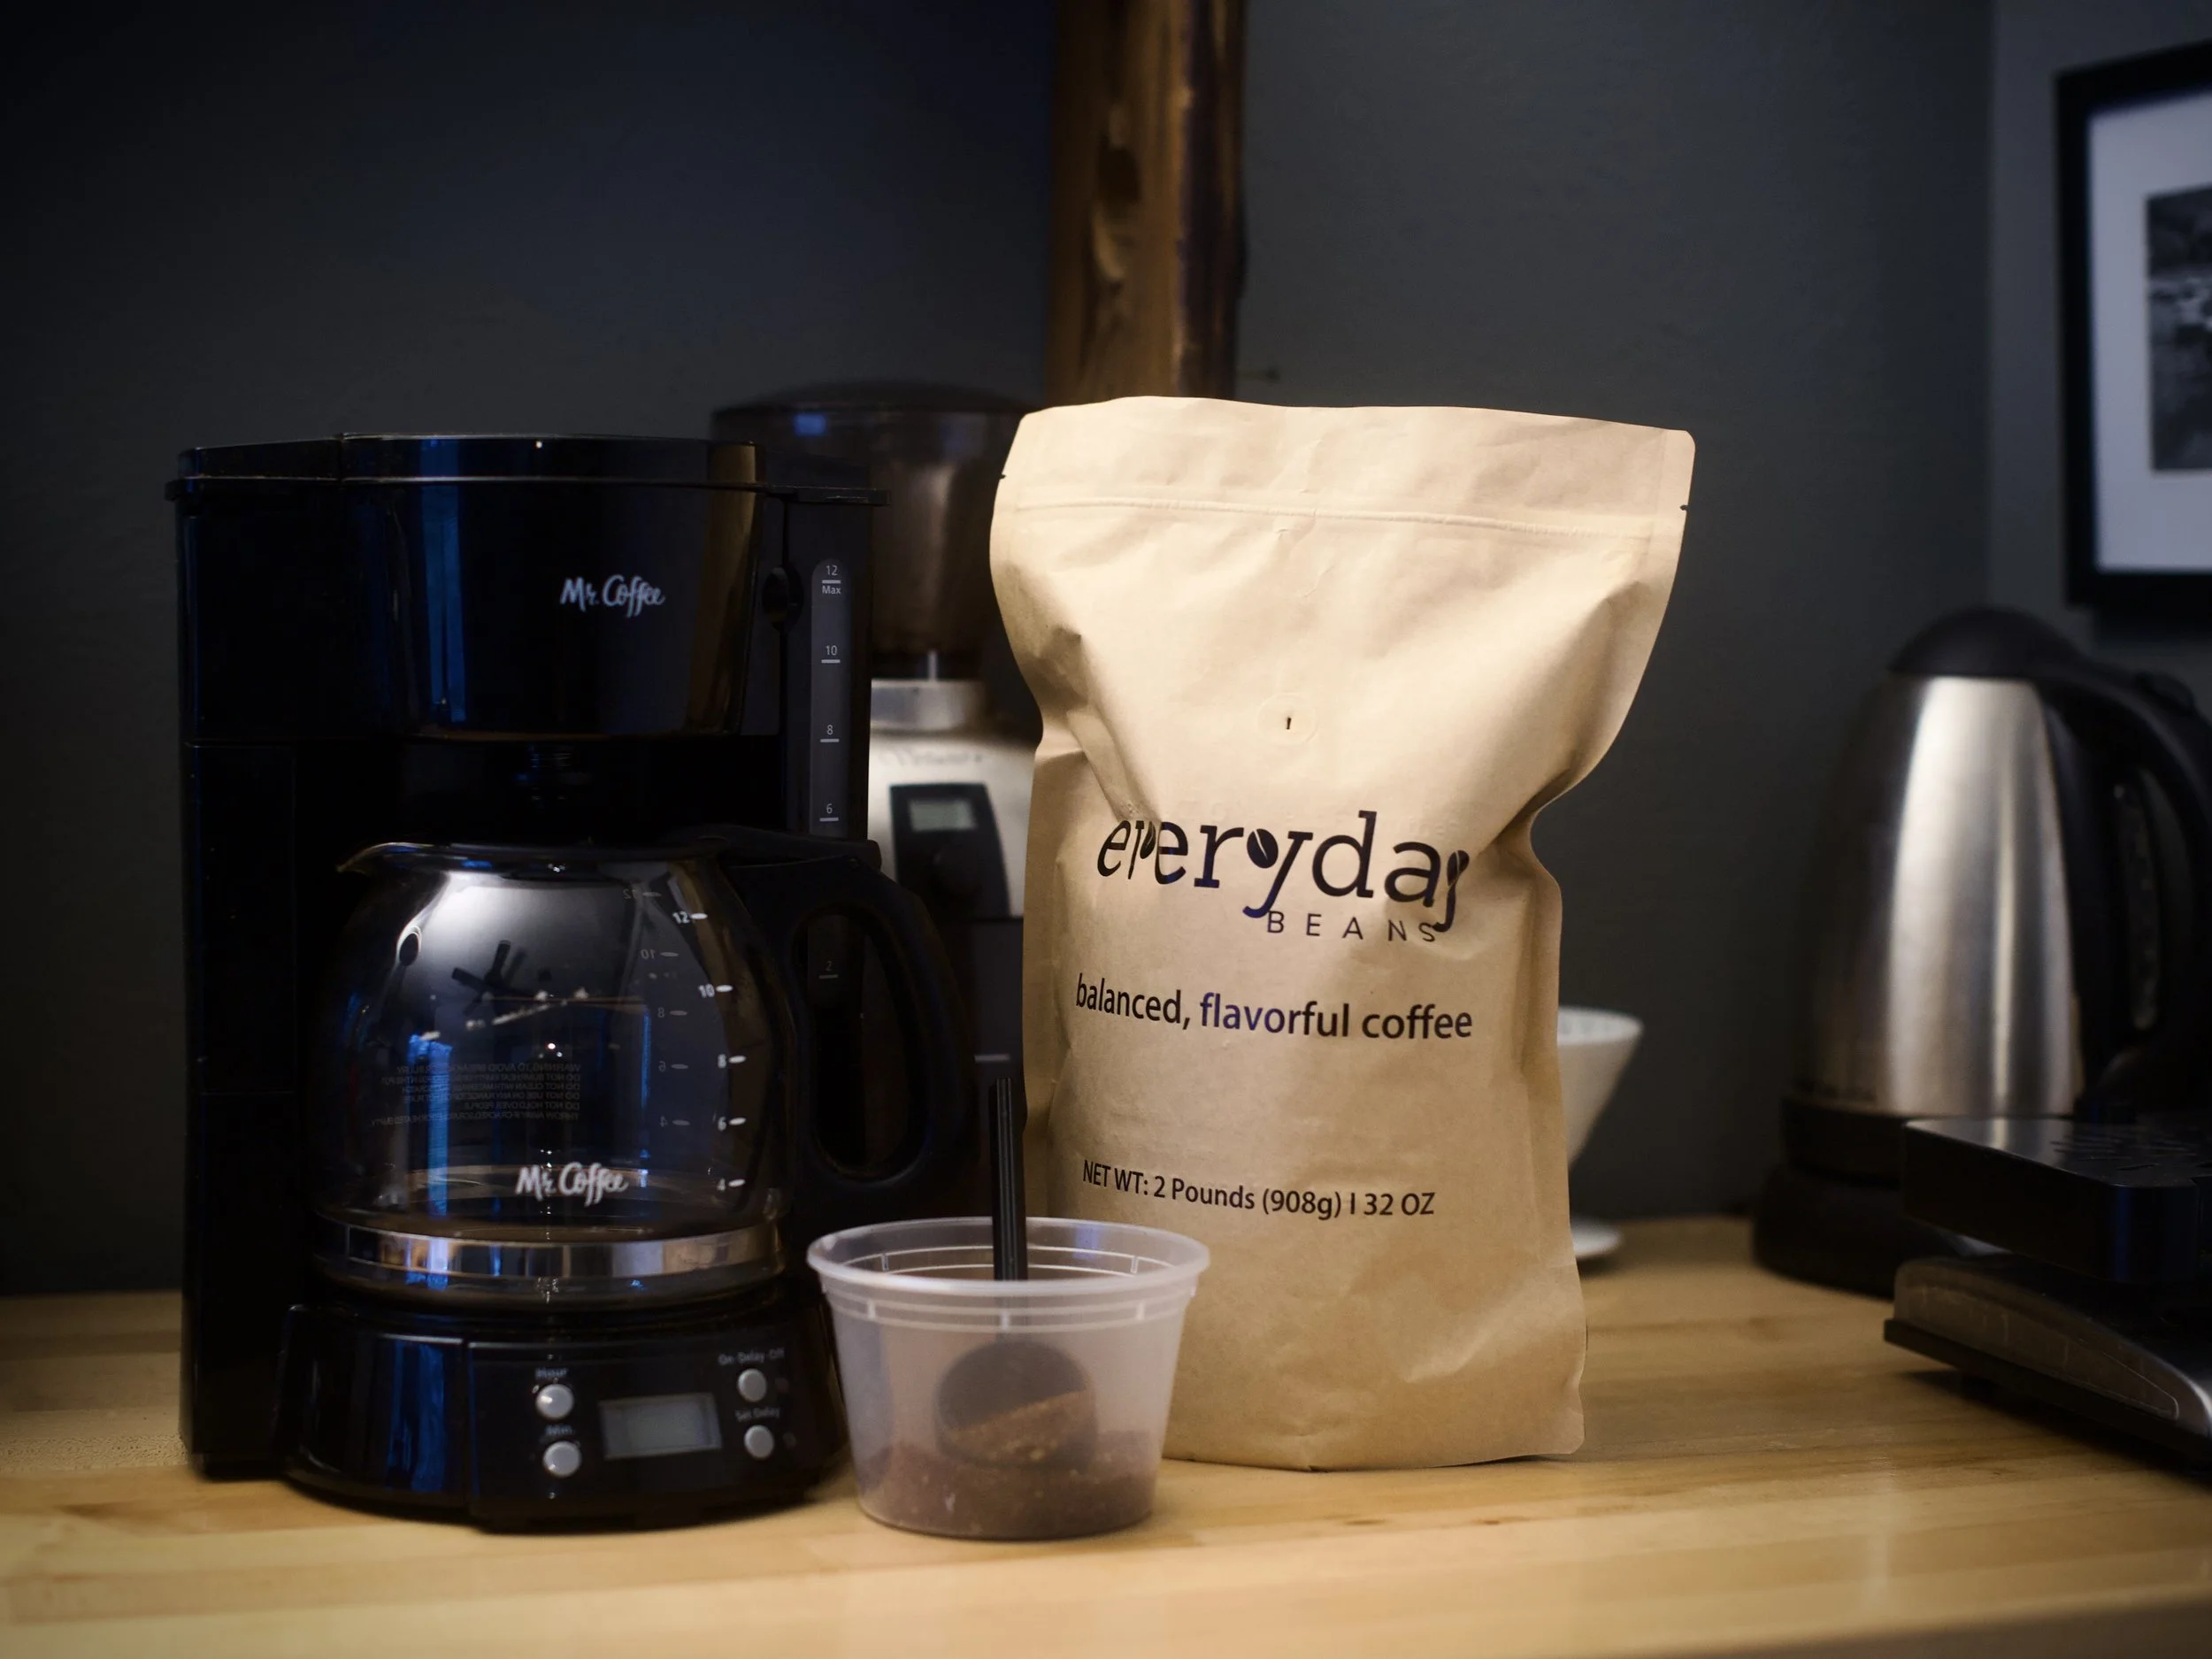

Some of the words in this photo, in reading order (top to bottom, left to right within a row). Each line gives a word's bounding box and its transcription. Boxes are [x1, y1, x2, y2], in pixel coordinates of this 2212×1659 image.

[826, 565, 838, 576] 12
[559, 576, 599, 612] Mr.
[601, 573, 666, 618] Coffee
[821, 585, 842, 595] Max
[825, 645, 838, 657] 10
[826, 724, 833, 735] 8
[826, 803, 833, 814] 6
[672, 910, 691, 925] 12
[1266, 910, 1437, 942] BEANS
[826, 960, 833, 972] 2
[697, 983, 716, 999] 10
[1075, 973, 1190, 1030] balanced,
[1200, 992, 1350, 1037] flavorful
[1361, 1004, 1473, 1039] coffee
[717, 1053, 728, 1069] 8
[717, 1116, 728, 1132] 6
[514, 1164, 557, 1202] Mr.
[557, 1160, 630, 1208] Coffee
[716, 1178, 726, 1192] 4
[1083, 1159, 1111, 1187] NET
[1114, 1167, 1148, 1195] WT:
[1153, 1175, 1166, 1199] 2
[1171, 1178, 1256, 1210] Pounds
[1262, 1188, 1341, 1221] (908g)
[1363, 1193, 1394, 1216] 32
[1401, 1192, 1436, 1216] OZ
